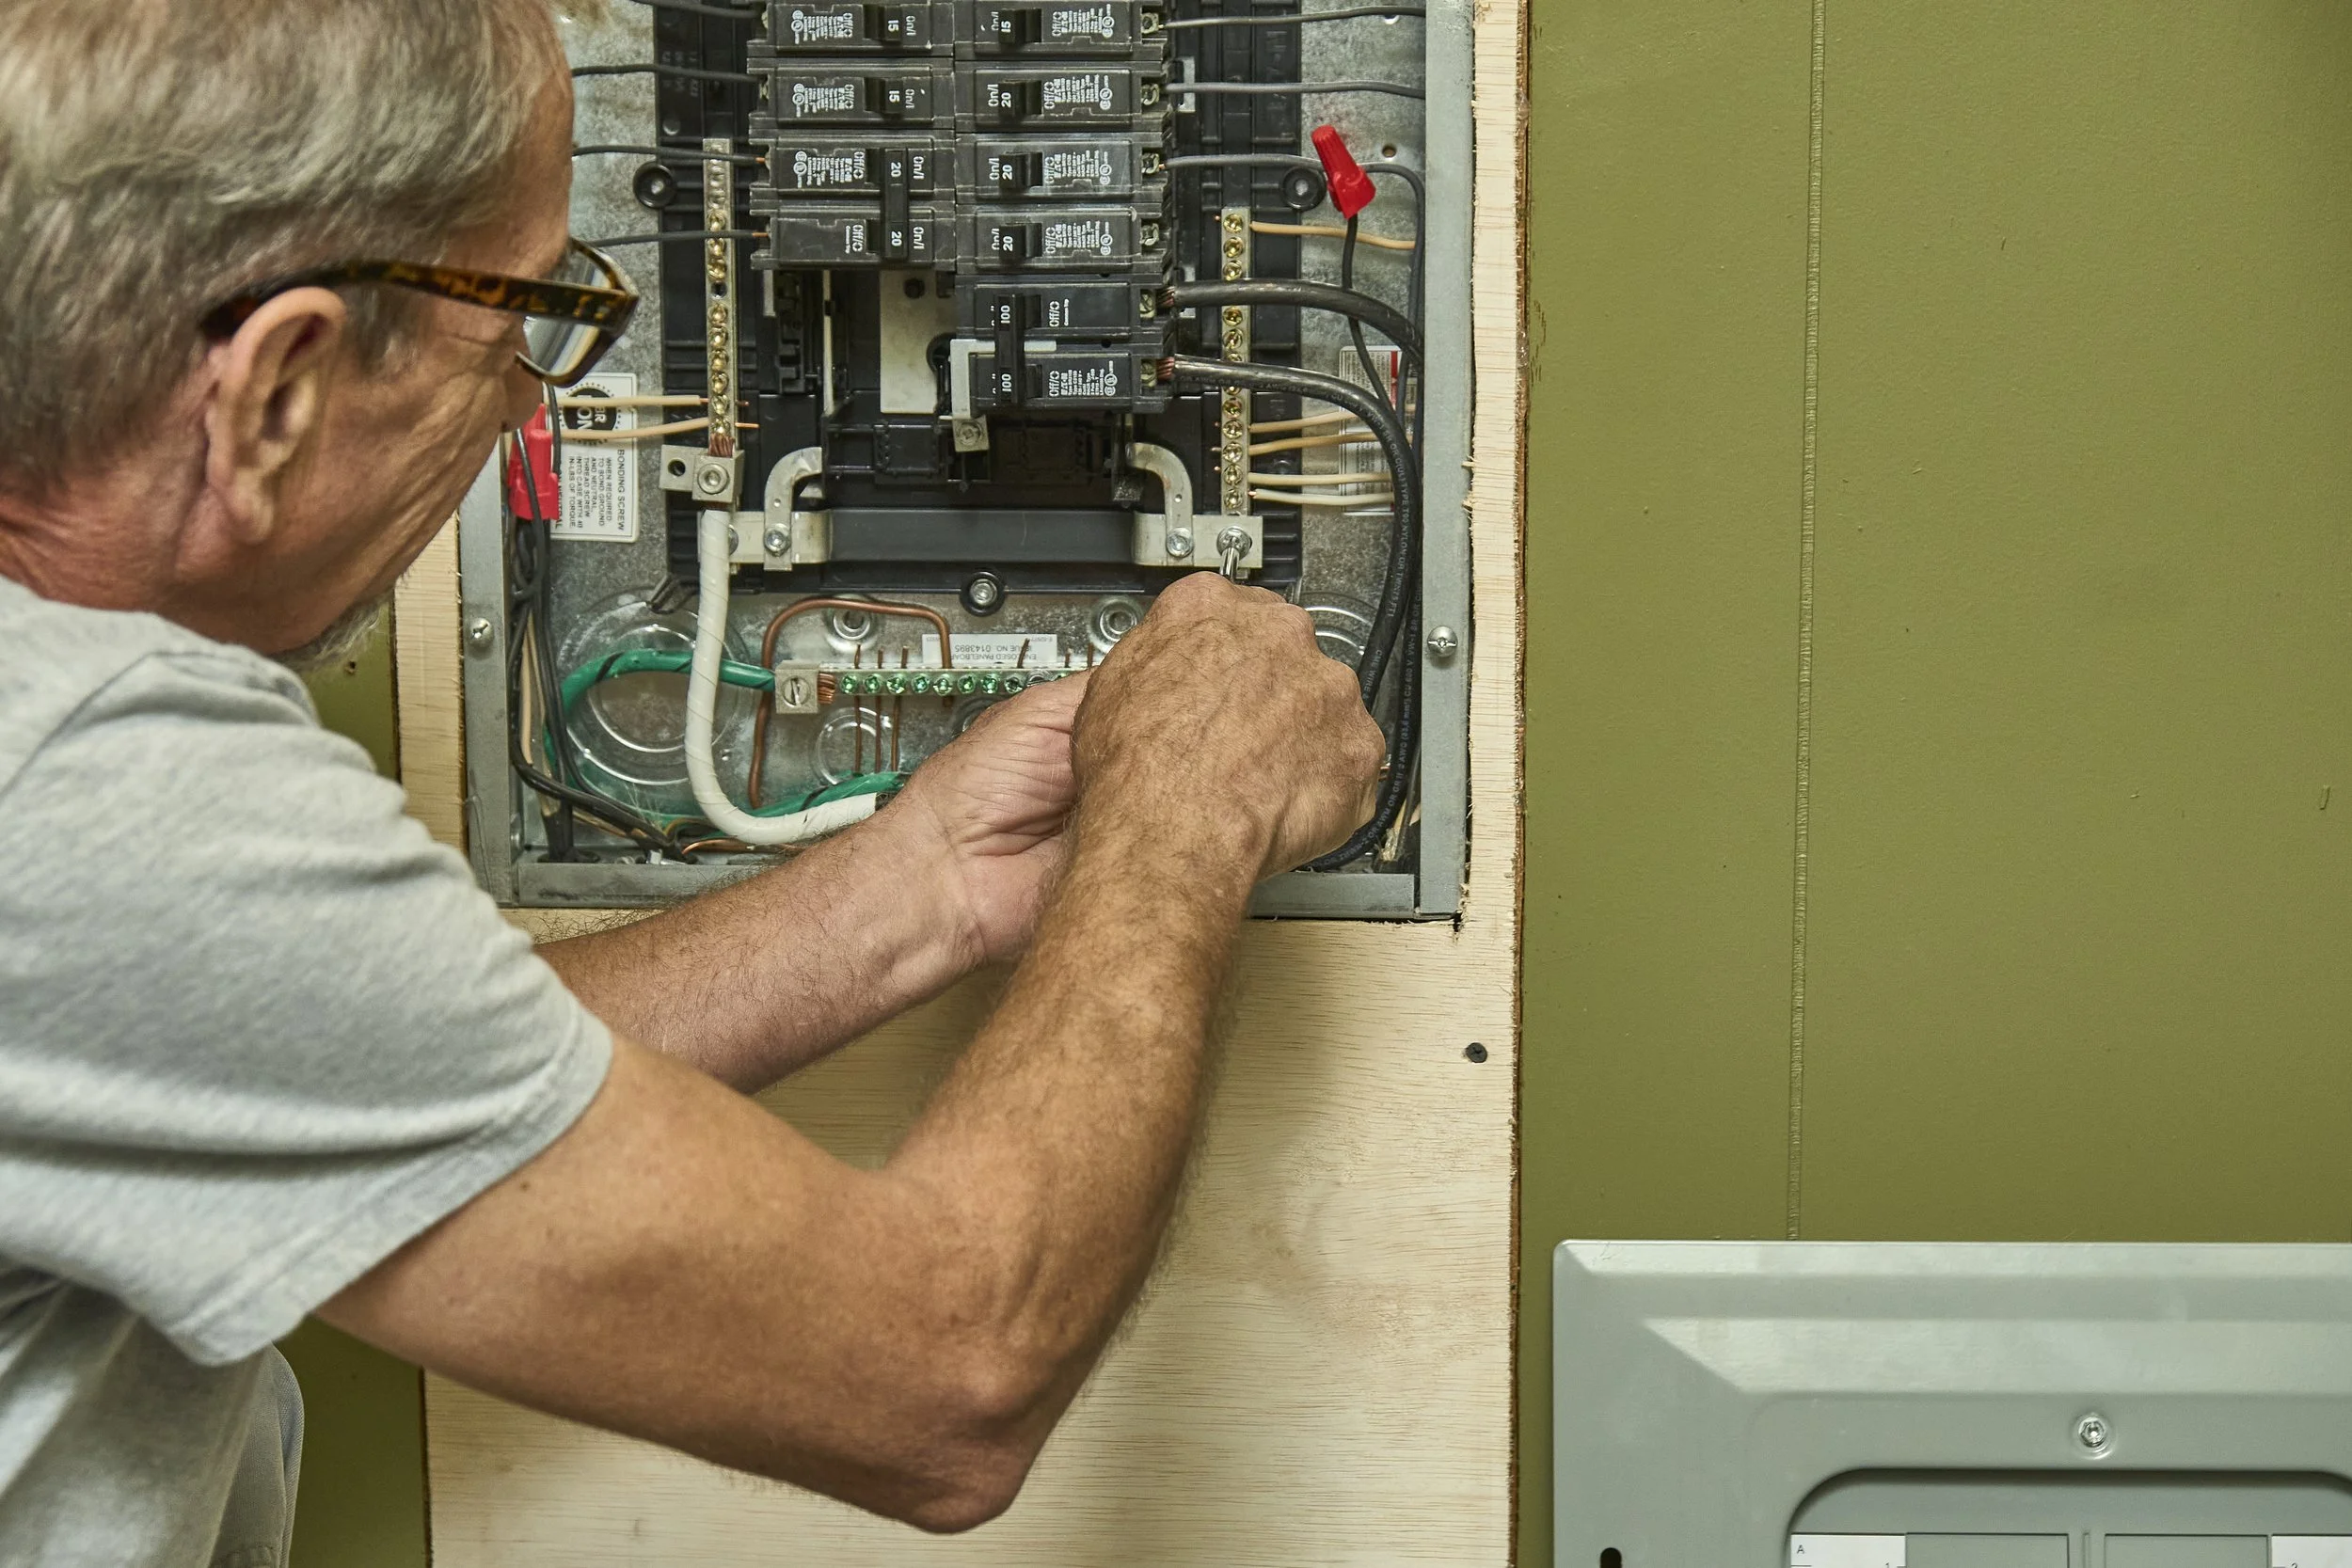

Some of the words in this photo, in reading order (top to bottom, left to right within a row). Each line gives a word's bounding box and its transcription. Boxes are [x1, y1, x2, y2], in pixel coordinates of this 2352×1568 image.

[888, 20, 898, 33] 15
[1001, 21, 1011, 33] 15
[889, 90, 900, 103] 15
[1001, 92, 1011, 108] 20
[890, 162, 901, 177] 20
[1002, 165, 1013, 180] 20
[891, 231, 902, 246] 20
[1003, 236, 1013, 251] 20
[1001, 305, 1010, 324] 100
[1001, 373, 1012, 392] 100
[1390, 443, 1400, 456] OR
[598, 457, 605, 467] TO
[617, 449, 626, 492] BONDING
[568, 483, 575, 494] OF
[1400, 482, 1409, 505] TYPE
[617, 496, 626, 531] SCREW
[1399, 525, 1409, 555] NYLON
[1397, 557, 1406, 570] OR
[1365, 669, 1376, 692] WIRE
[1366, 826, 1381, 840] OR
[1387, 792, 1399, 807] OR
[1796, 1544, 1805, 1554] A
